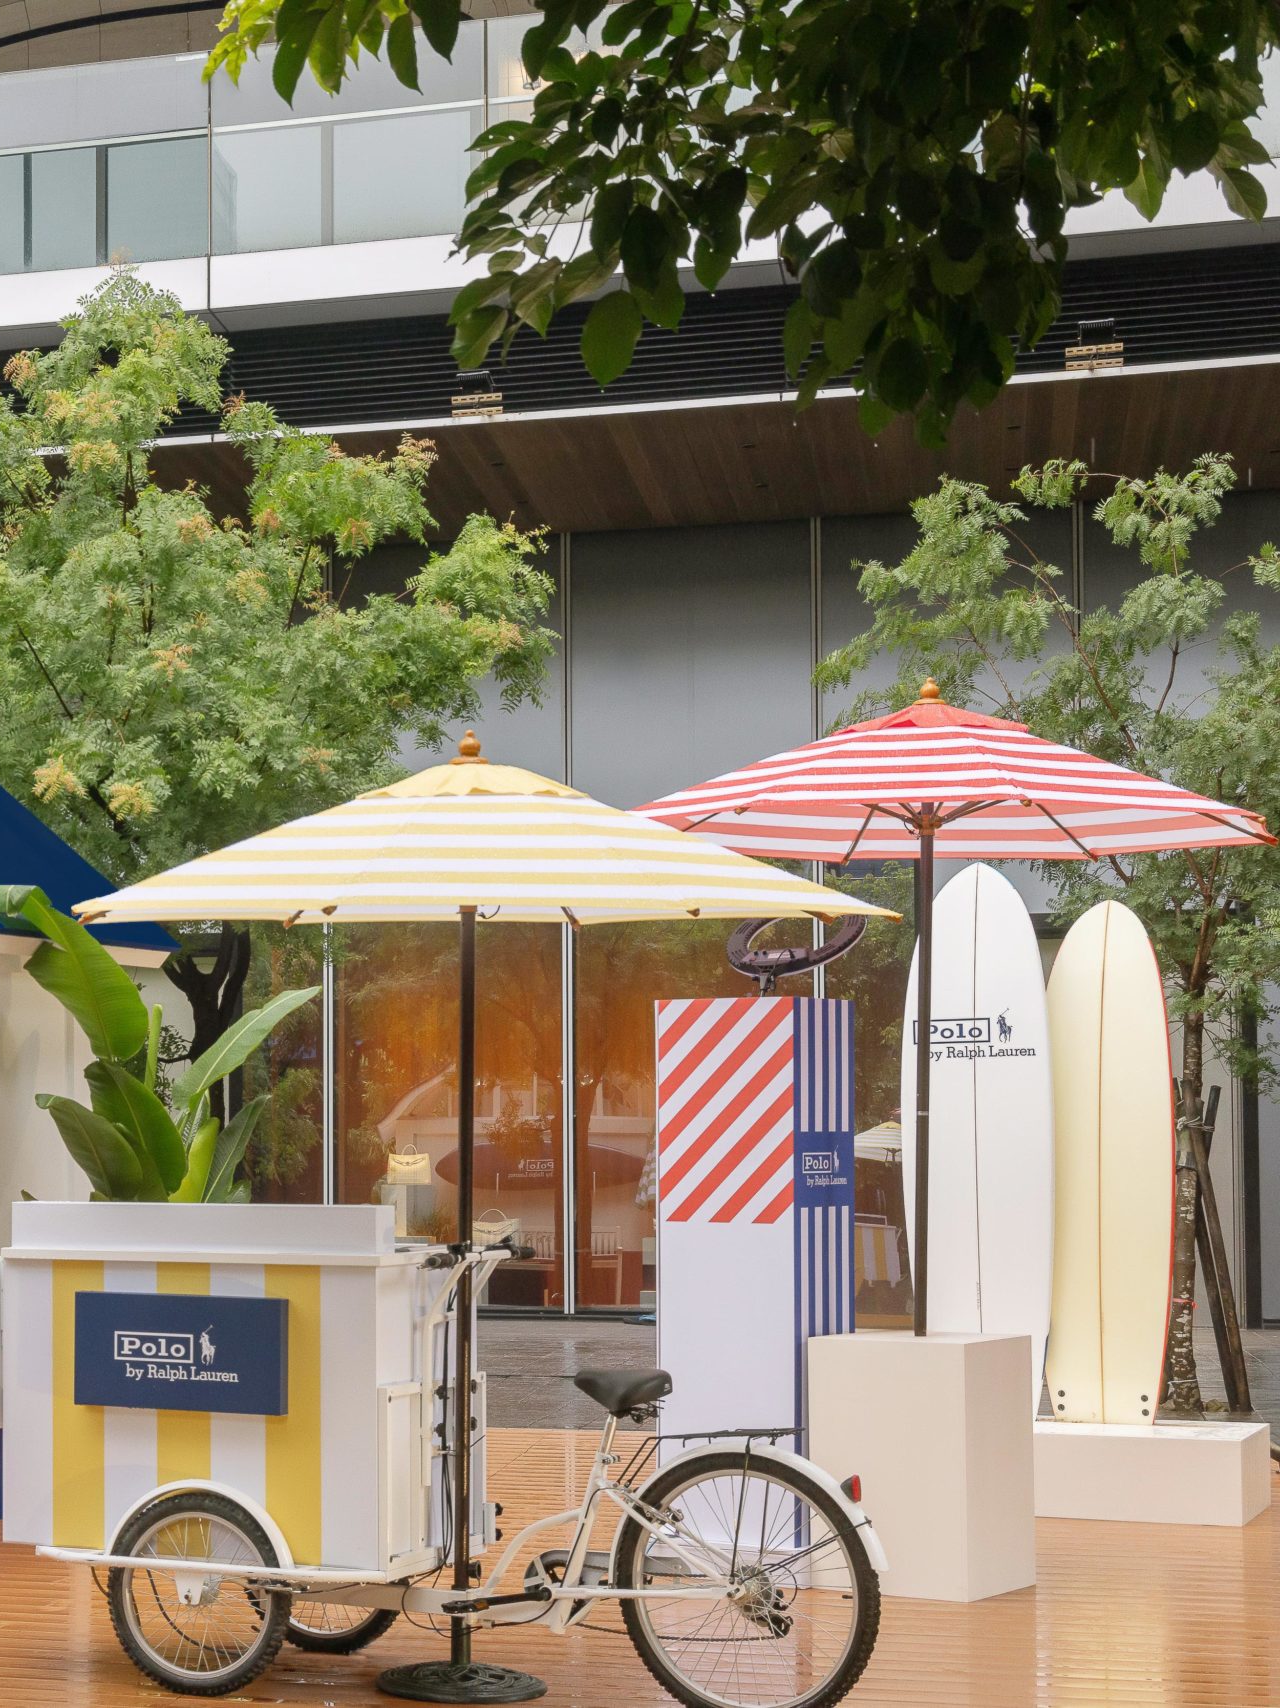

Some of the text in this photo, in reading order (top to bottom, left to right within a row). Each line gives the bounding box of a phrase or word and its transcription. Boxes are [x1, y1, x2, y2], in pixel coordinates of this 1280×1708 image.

[946, 1045, 987, 1060] Ralph
[988, 1045, 1037, 1058] Lauren
[804, 1156, 829, 1170] Polo
[806, 1175, 815, 1188] by
[815, 1174, 830, 1187] Ralph
[120, 1336, 186, 1358] Polo
[125, 1362, 240, 1383] by Ralph Lauren
